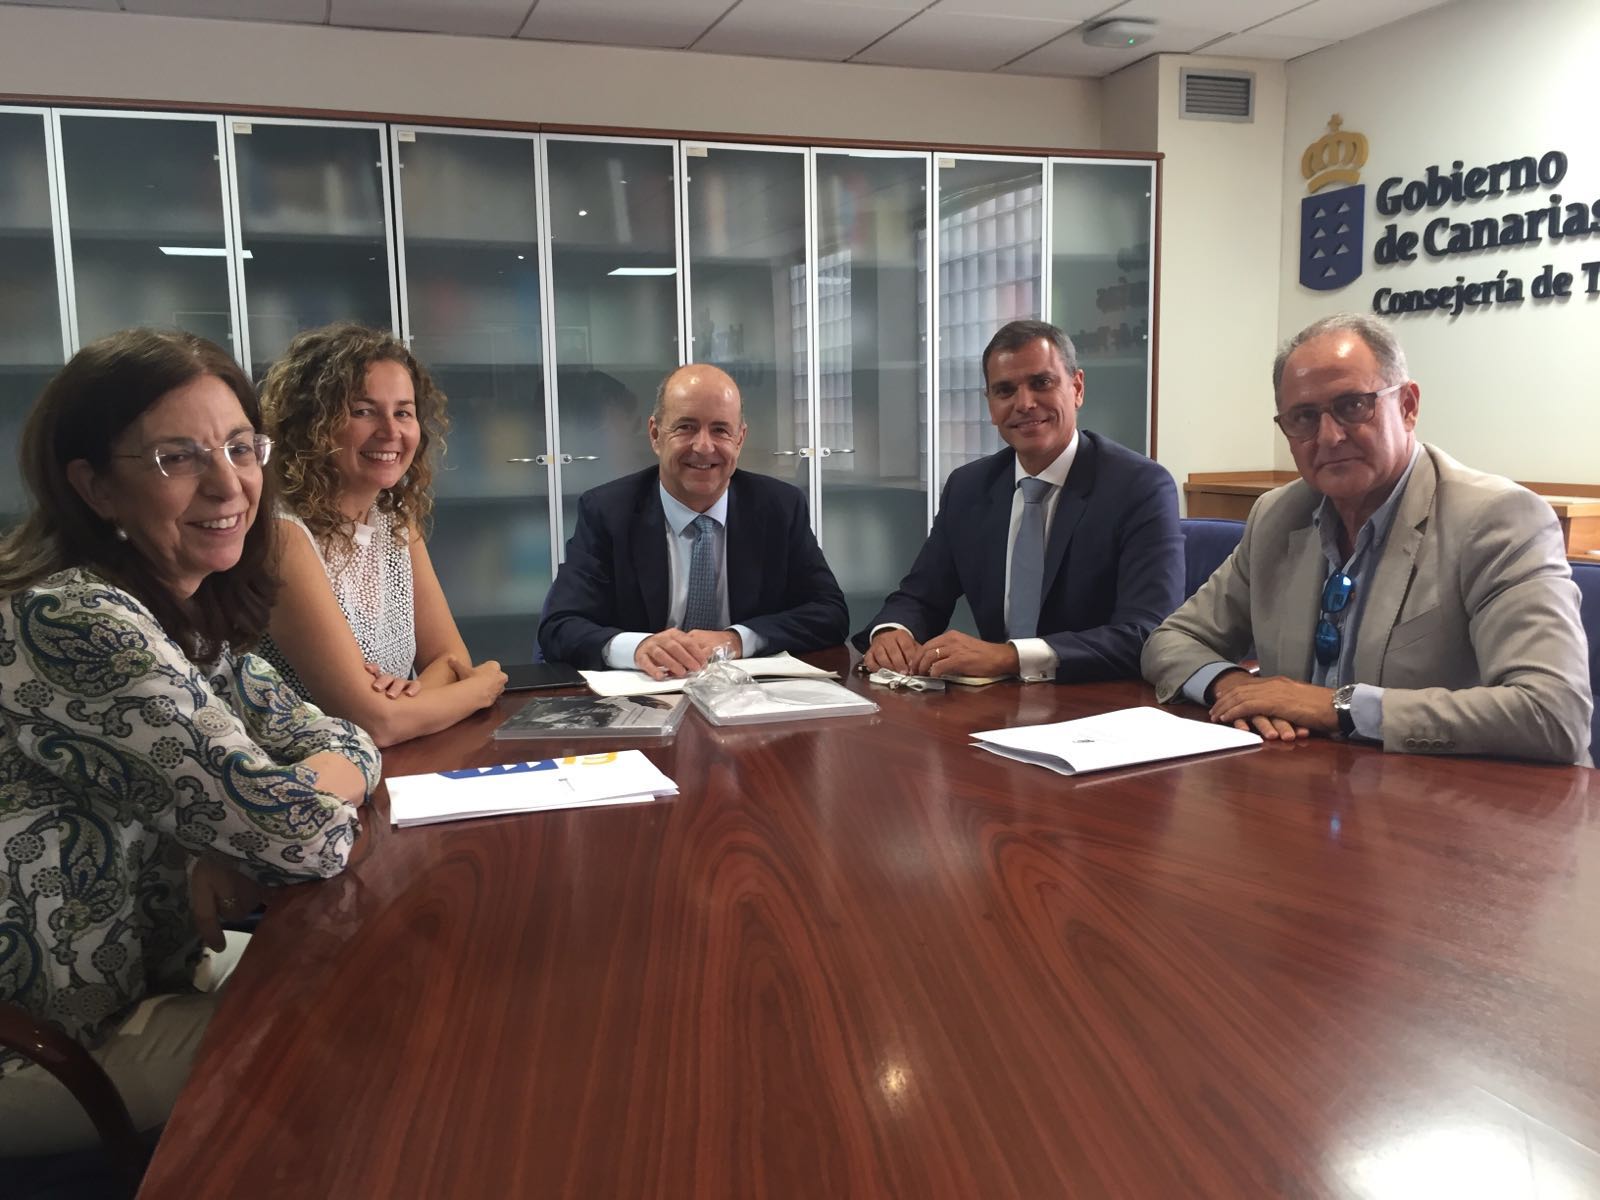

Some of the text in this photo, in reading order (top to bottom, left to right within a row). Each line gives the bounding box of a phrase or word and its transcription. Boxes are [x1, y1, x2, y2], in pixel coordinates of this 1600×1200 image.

[1376, 150, 1568, 216] Gobierno
[1374, 223, 1419, 265] de
[1372, 269, 1525, 316] Consejería
[1531, 264, 1574, 299] de
